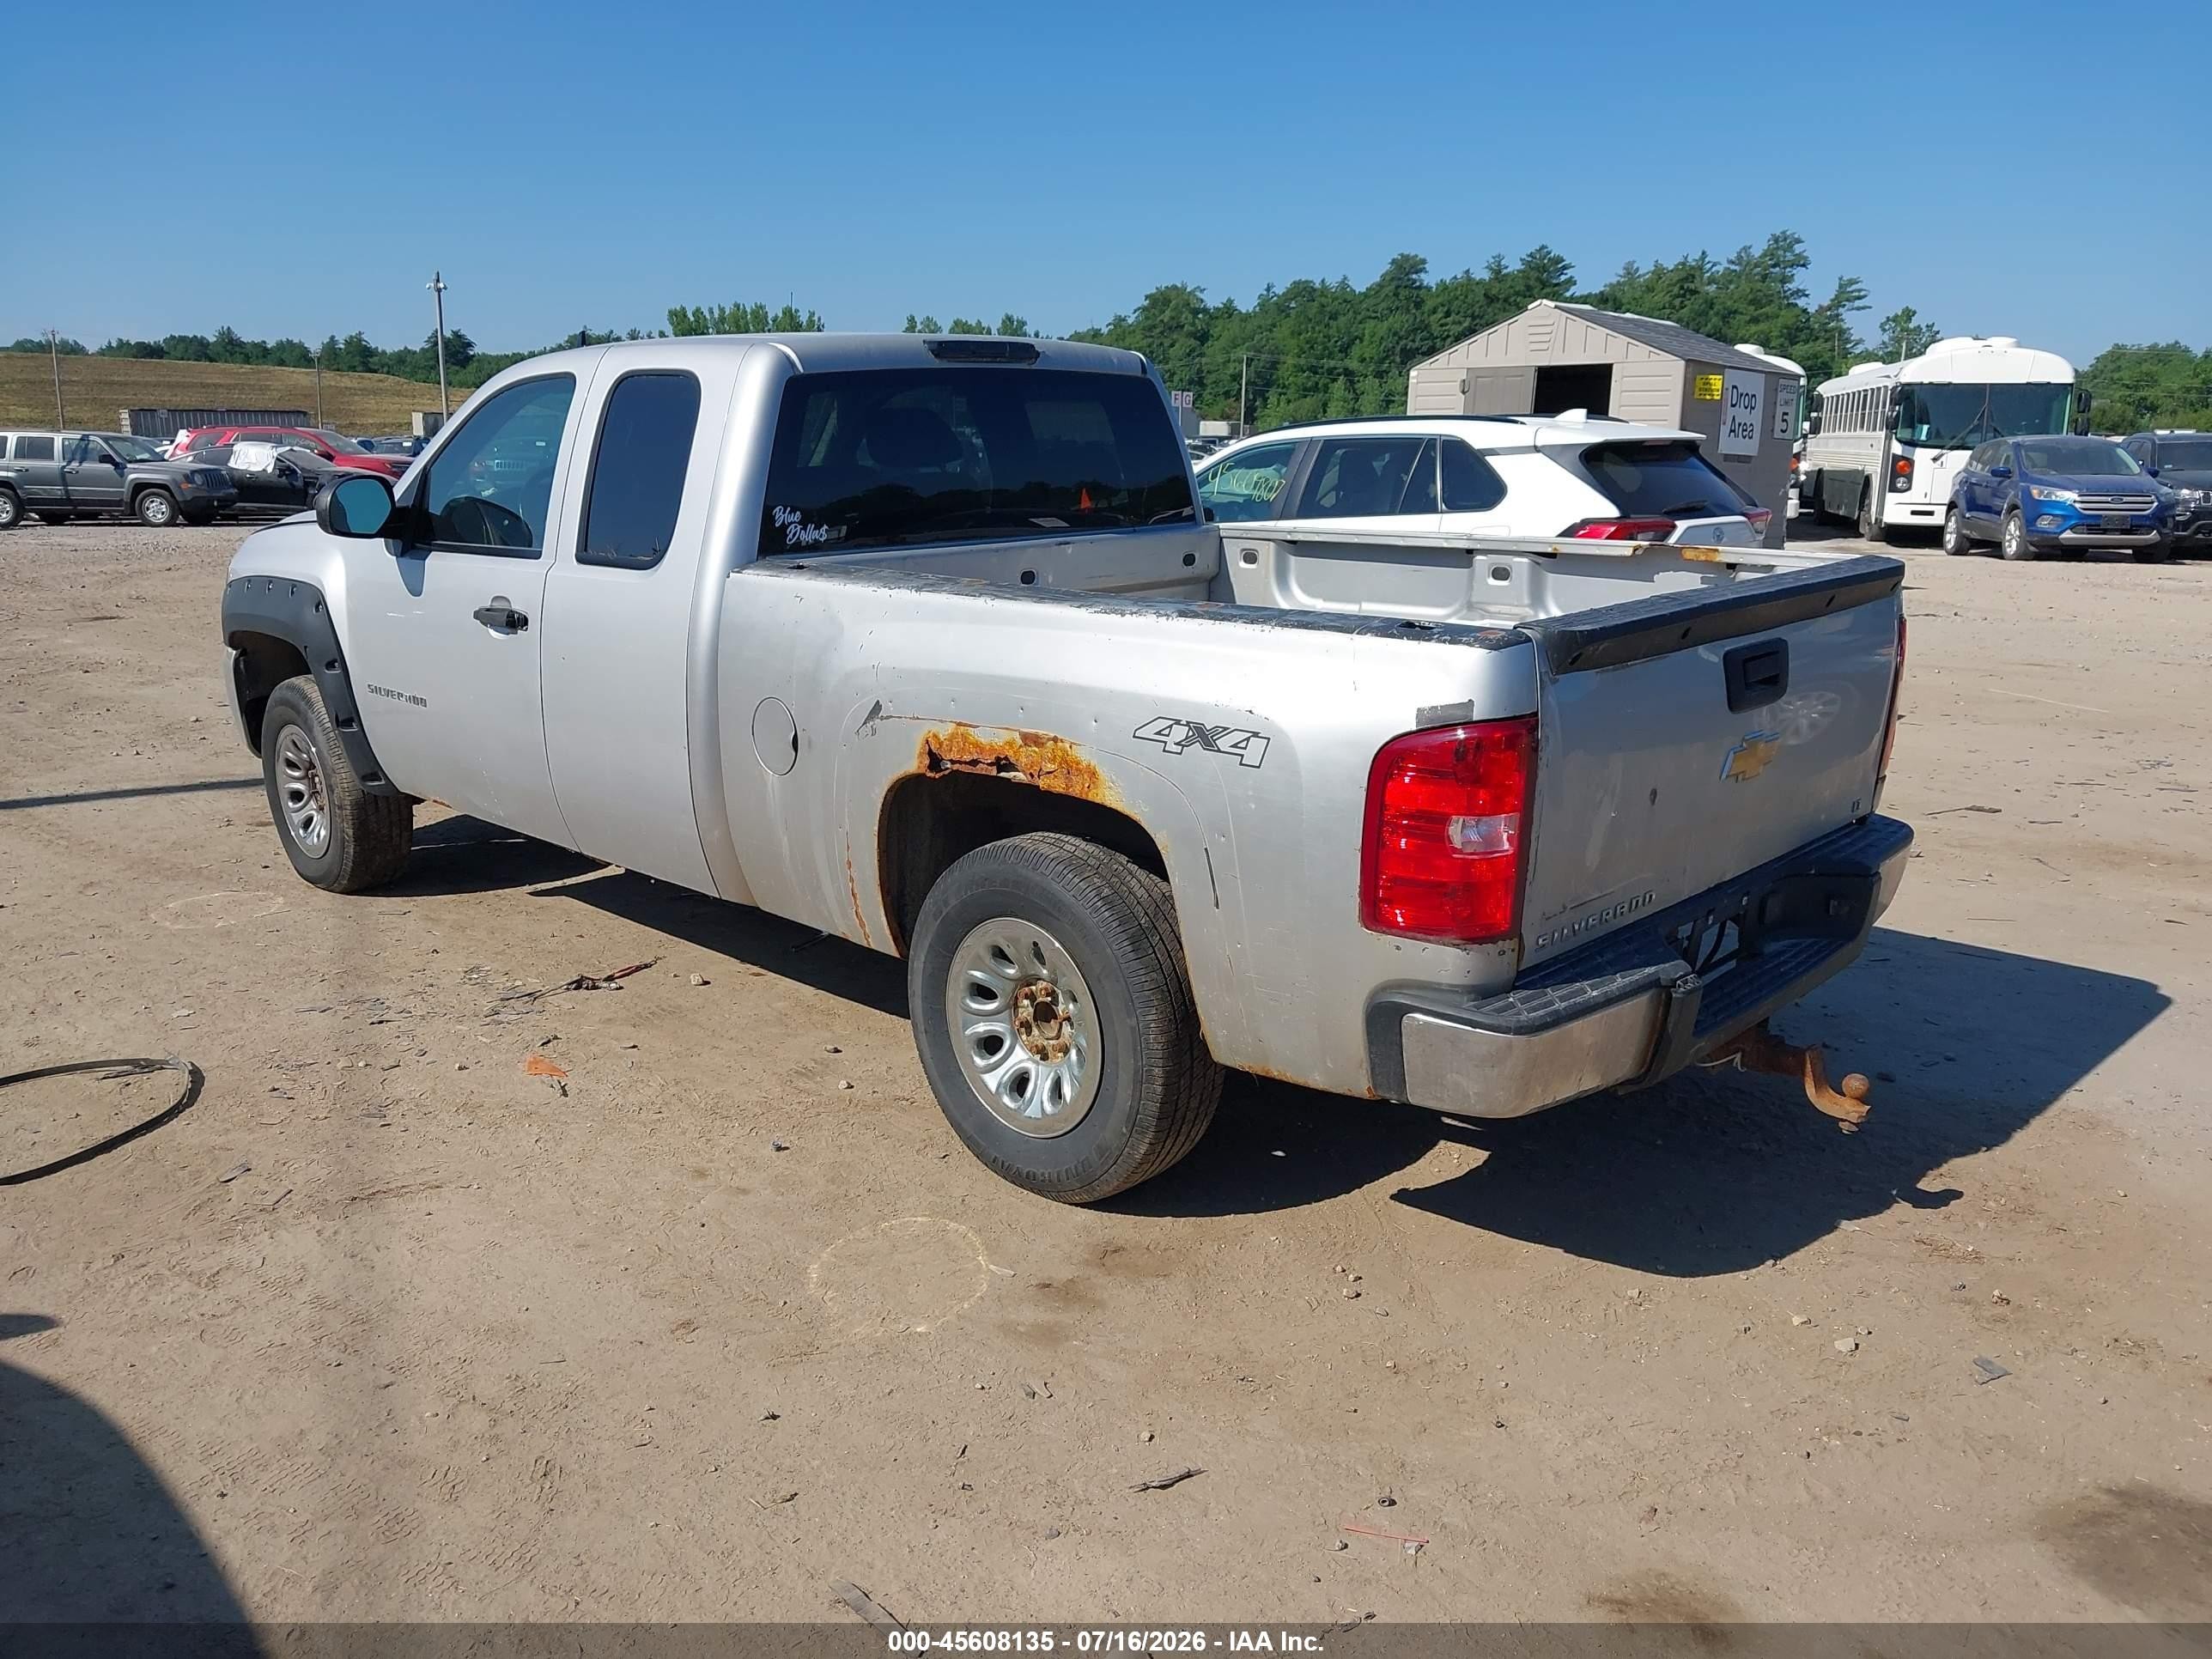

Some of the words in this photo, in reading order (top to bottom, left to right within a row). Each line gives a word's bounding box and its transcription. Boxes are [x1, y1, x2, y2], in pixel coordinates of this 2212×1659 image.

[1174, 393, 1181, 404] F
[1184, 394, 1192, 405] G
[1730, 385, 1757, 414] Drop
[1779, 384, 1796, 394] SPEED
[1779, 398, 1794, 406] LIMIT
[1728, 415, 1754, 440] Area
[1779, 411, 1790, 434] 5
[772, 505, 802, 527] Blue
[1534, 890, 1656, 952] SILVERADO
